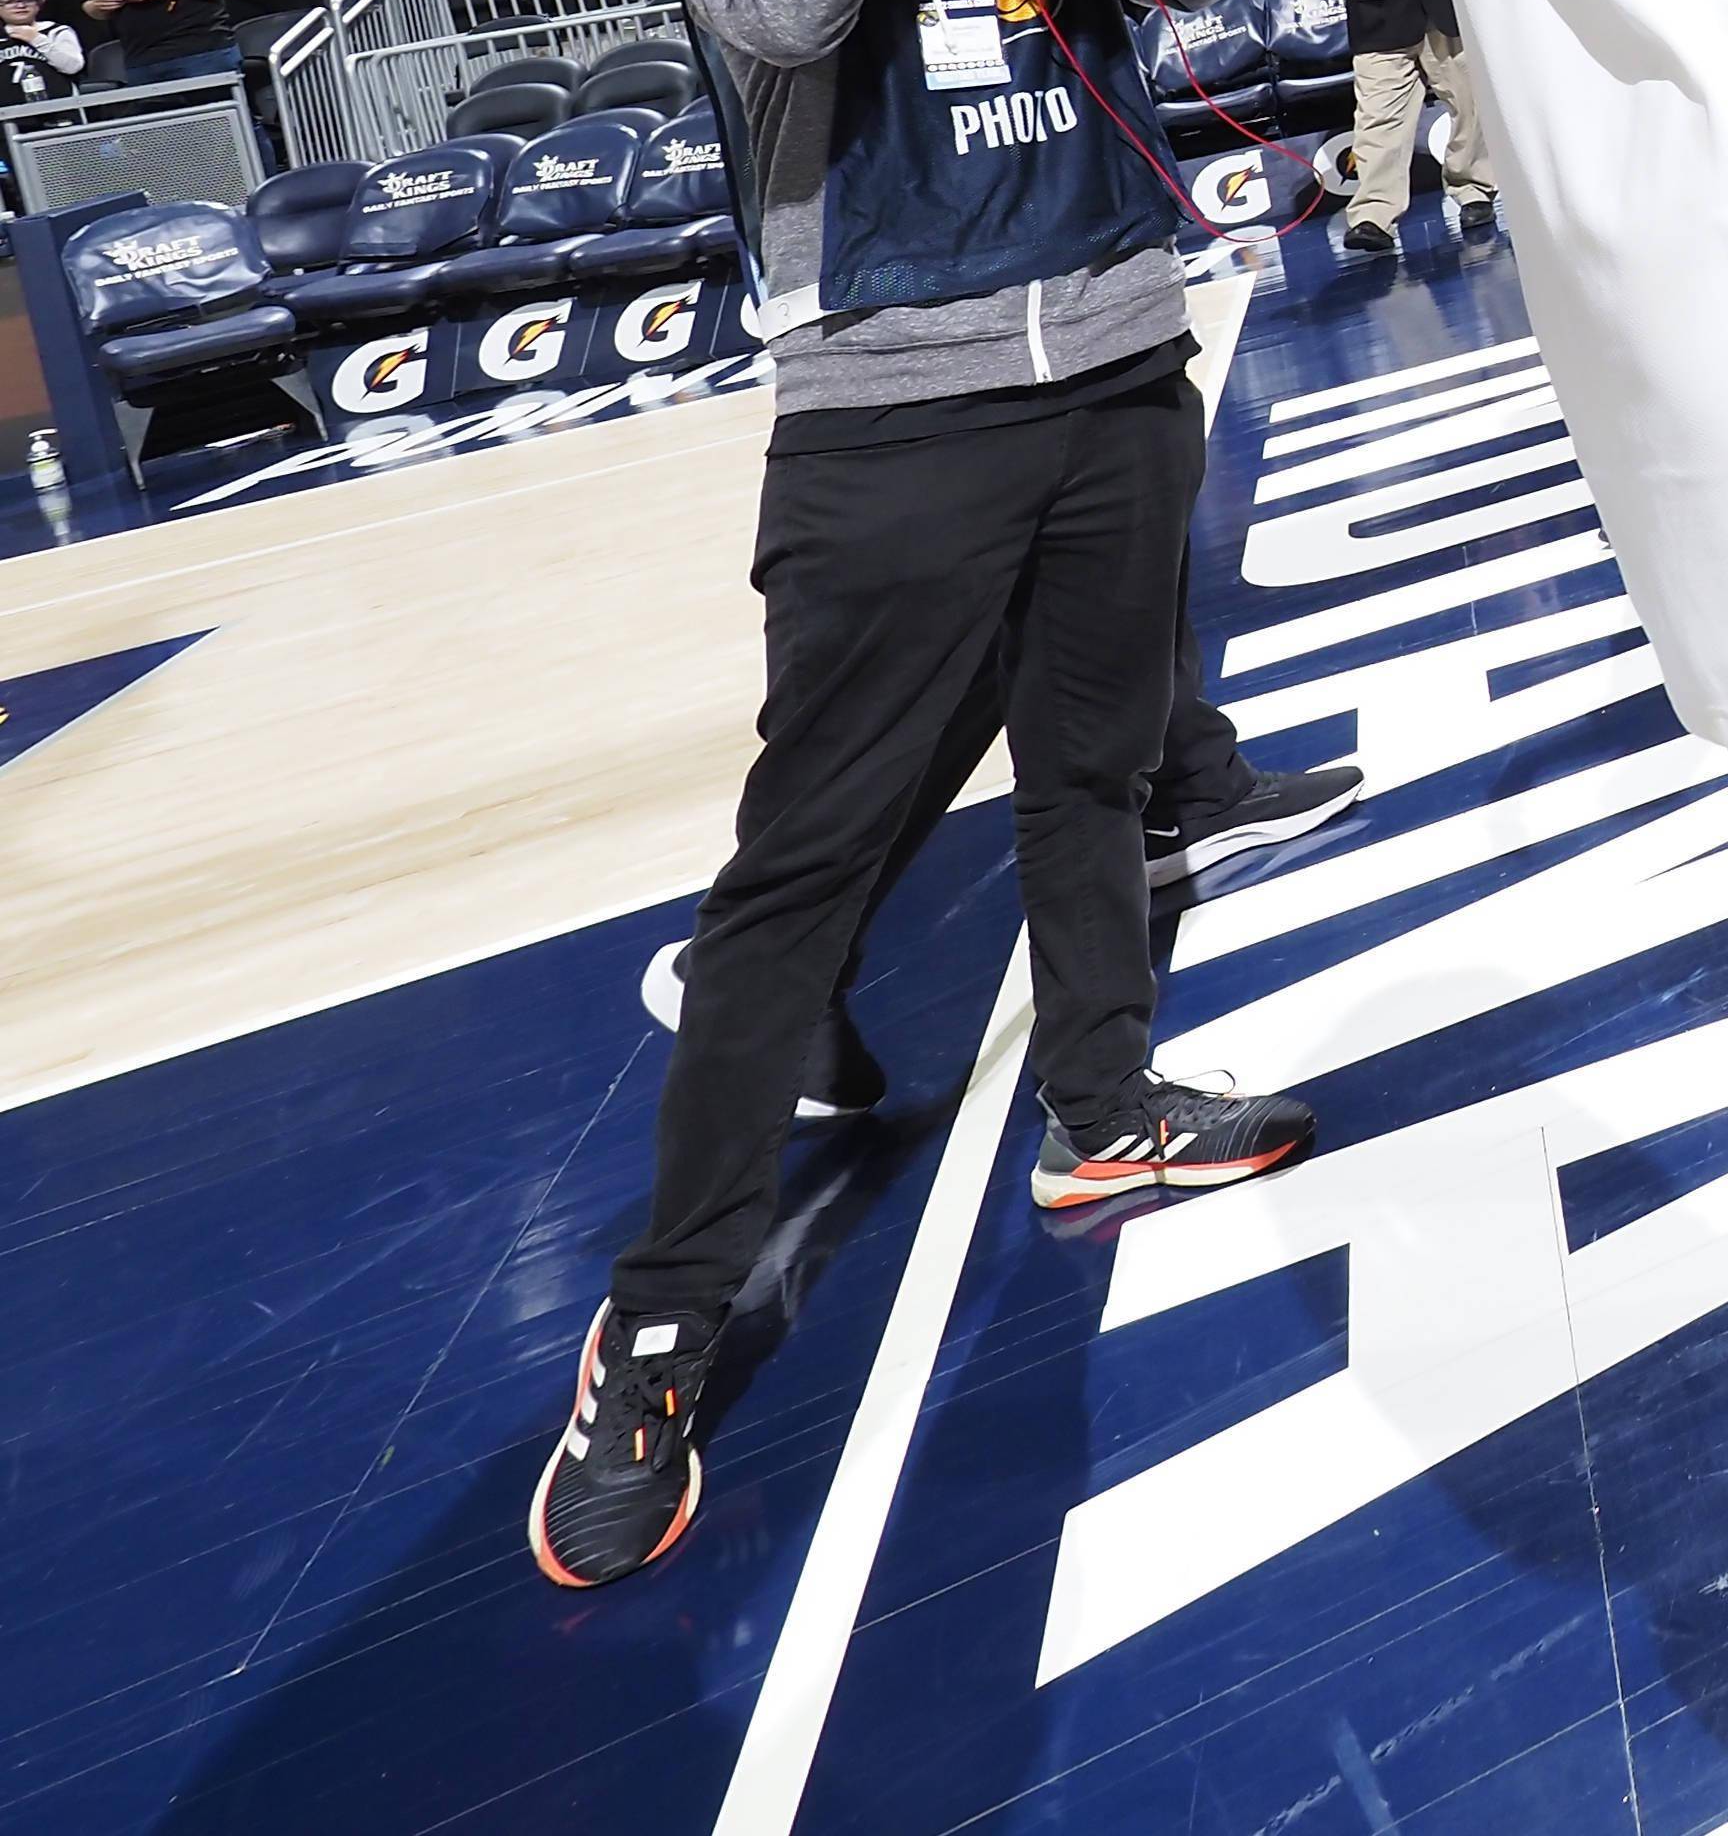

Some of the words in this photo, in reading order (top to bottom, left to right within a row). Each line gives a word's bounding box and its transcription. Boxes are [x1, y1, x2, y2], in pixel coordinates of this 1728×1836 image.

[382, 170, 454, 193] DRAFT
[536, 159, 600, 178] DRAFT
[1191, 148, 1273, 225] G
[113, 235, 204, 266] DRAFT
[128, 247, 204, 272] KINGS
[478, 297, 578, 382] G
[614, 277, 706, 363] G
[331, 326, 432, 414] G
